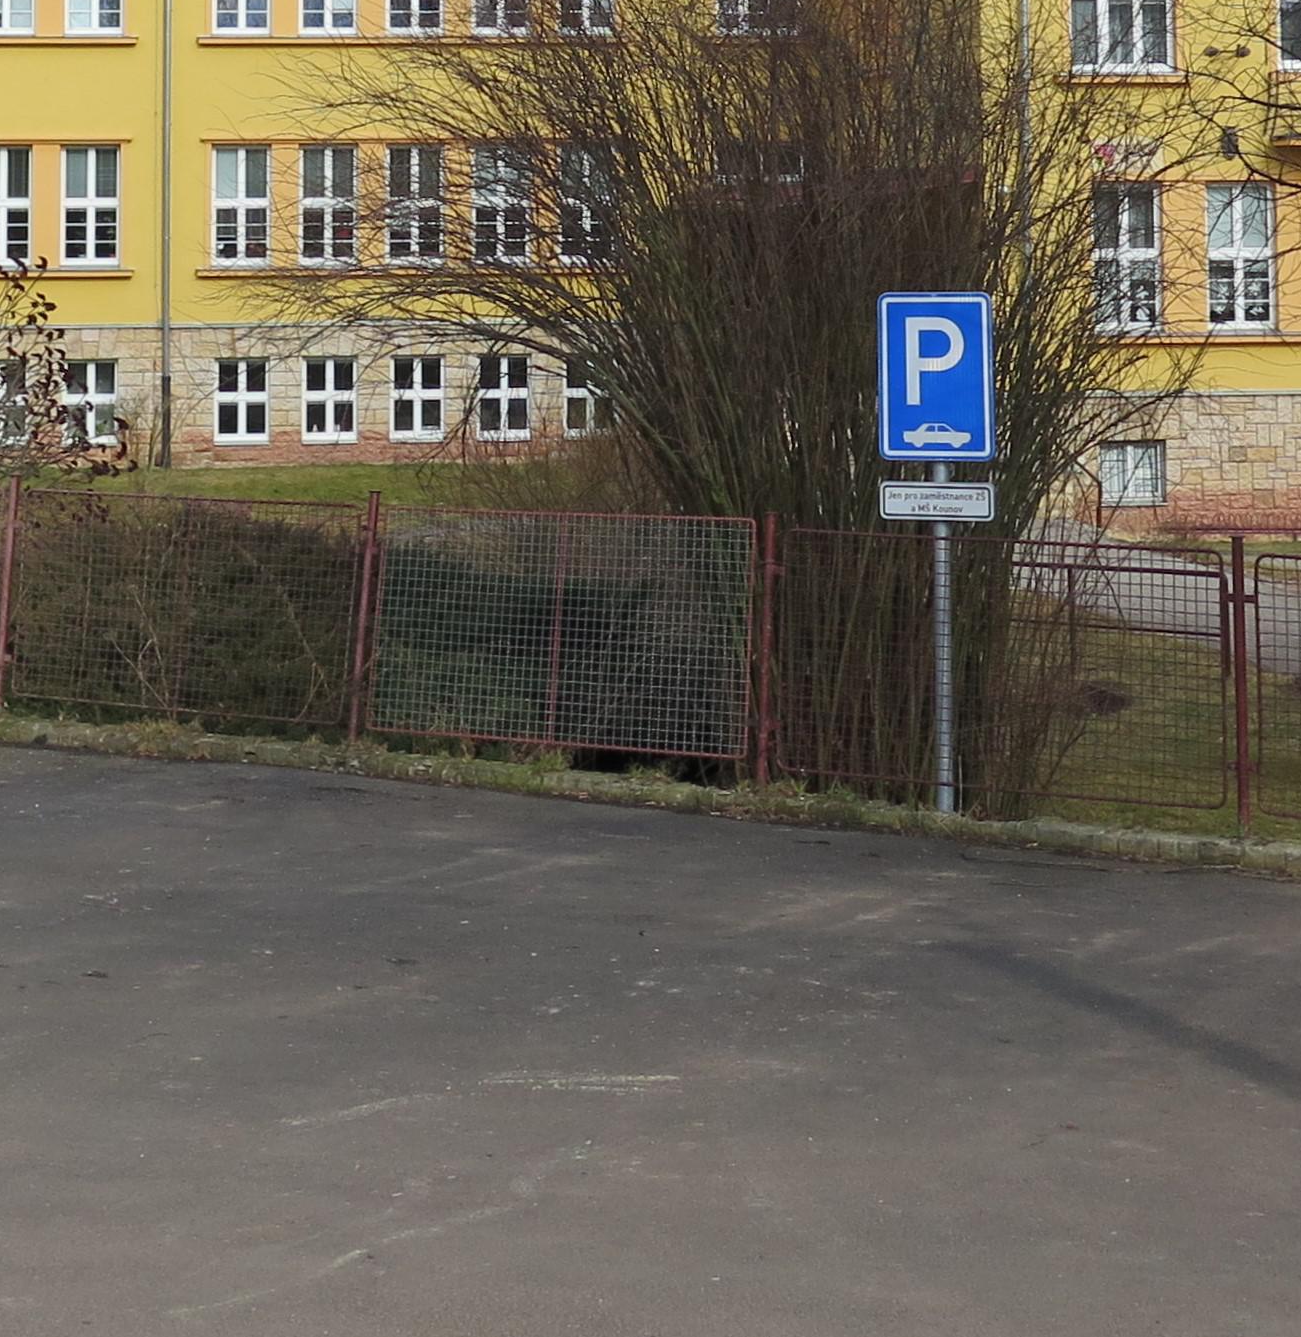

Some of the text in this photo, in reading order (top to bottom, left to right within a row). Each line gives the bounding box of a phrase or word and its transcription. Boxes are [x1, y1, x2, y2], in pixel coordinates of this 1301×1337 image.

[905, 316, 965, 406] P
[887, 491, 986, 502] Jen pro zaměstnance ZŠ
[918, 503, 930, 512] MŠ
[932, 505, 964, 513] Kounov
